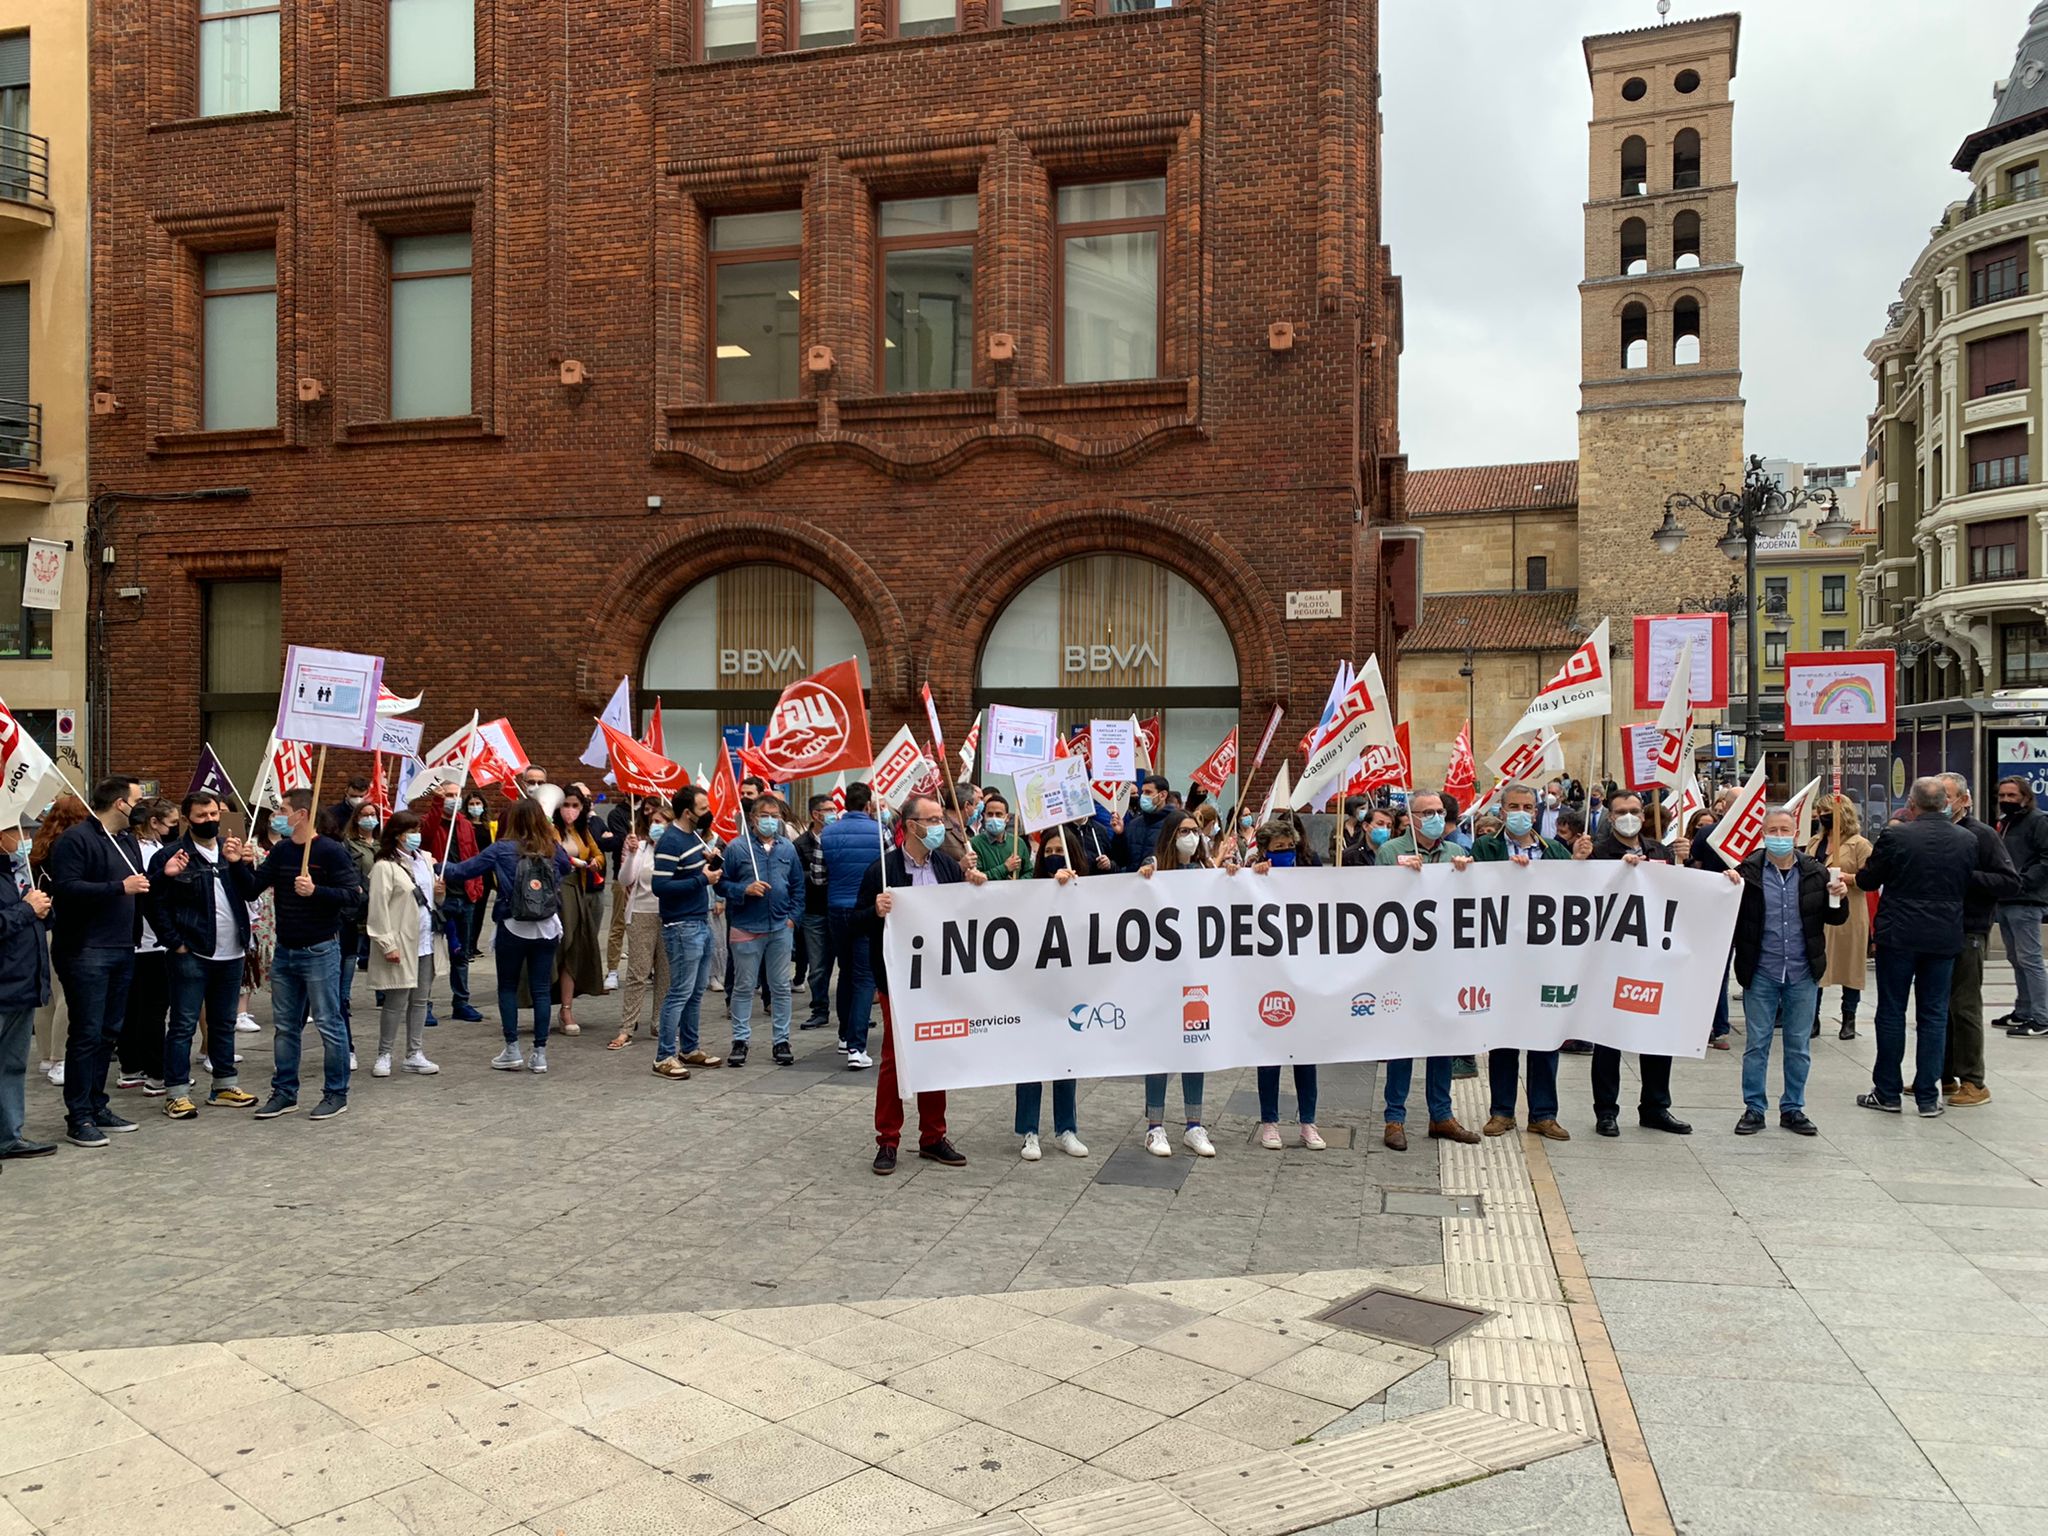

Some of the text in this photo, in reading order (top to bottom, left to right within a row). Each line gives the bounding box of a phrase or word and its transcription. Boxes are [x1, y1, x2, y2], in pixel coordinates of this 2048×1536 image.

[1755, 540, 1797, 550] MODERNA
[1294, 608, 1334, 616] REGUERAL
[720, 645, 806, 675] BBVA
[1064, 640, 1160, 672] BBVA
[1551, 699, 1560, 711] y
[1562, 689, 1595, 705] León
[1303, 721, 1368, 779] Castilla y León
[1034, 915, 1072, 969] A
[1088, 907, 1182, 966] LOS
[1197, 900, 1438, 959] DESPIDOS
[1453, 895, 1510, 950] EN
[1619, 984, 1660, 1003] SCAT
[1263, 996, 1291, 1012] UGT
[1351, 1004, 1376, 1016] sec
[917, 1014, 1021, 1039] CCOO servicios
[968, 1026, 988, 1035] bbva
[1185, 1019, 1208, 1030] CGT
[1183, 1033, 1211, 1044] BBVA
